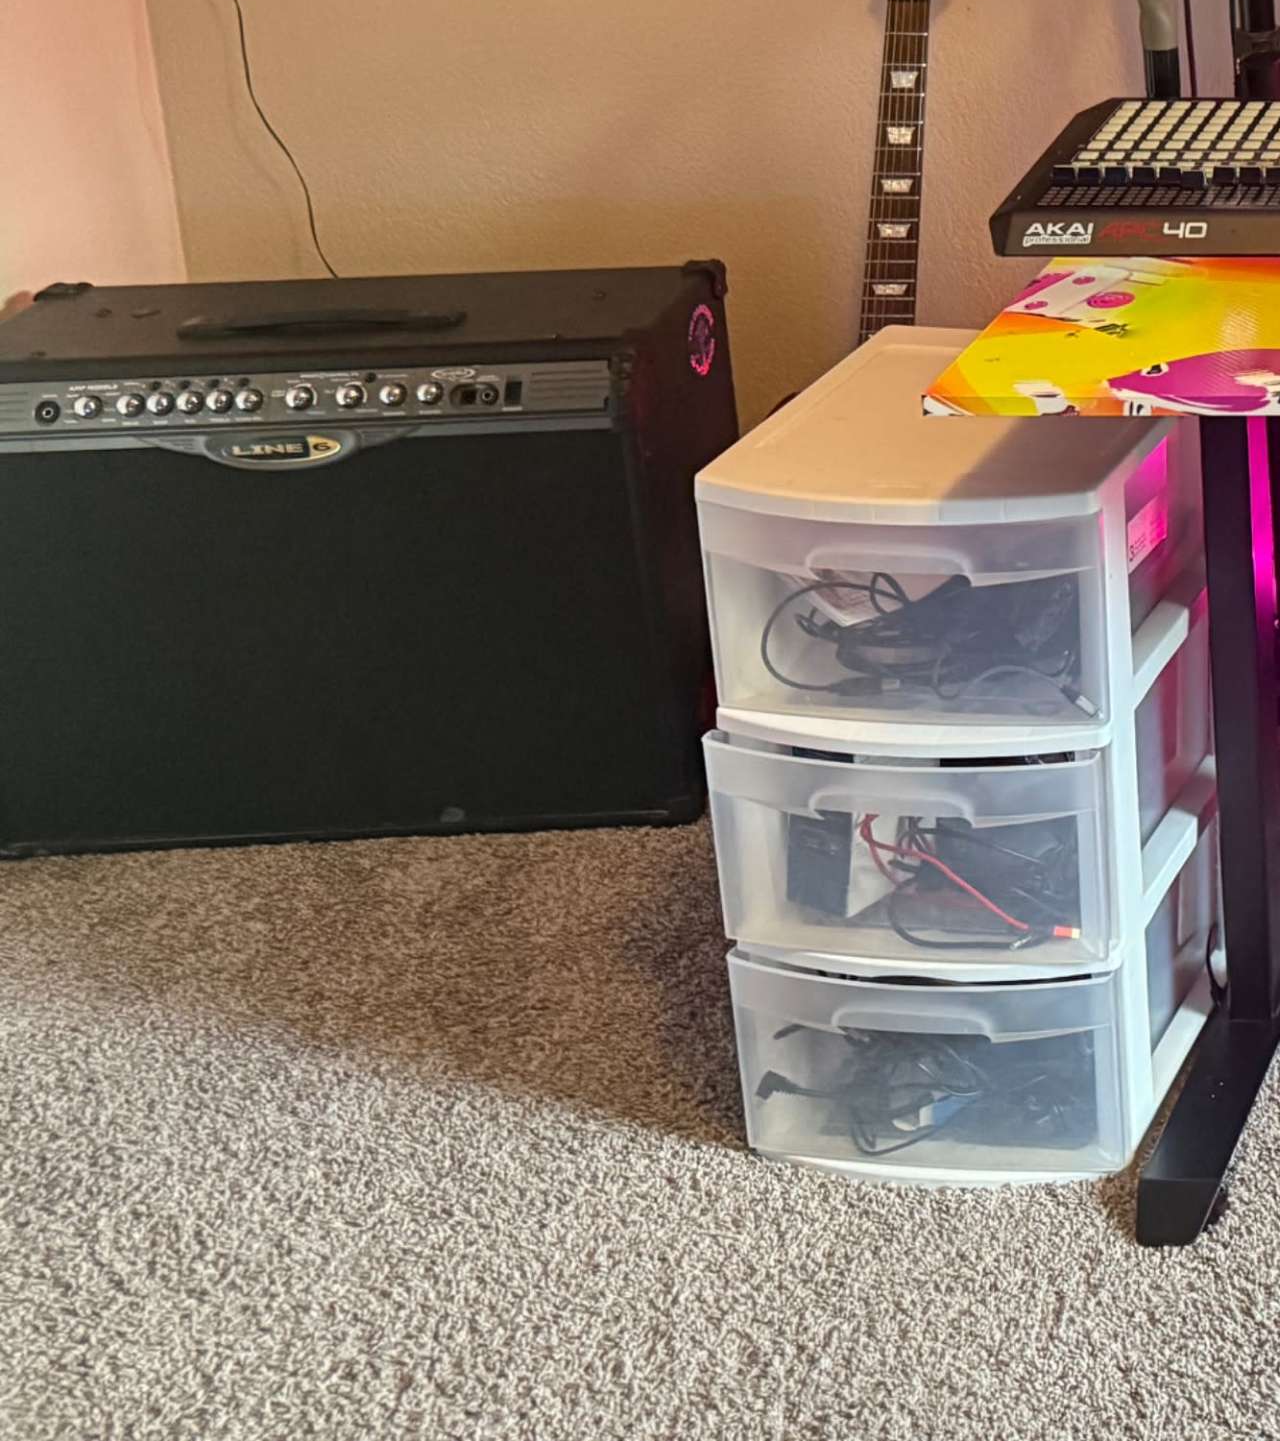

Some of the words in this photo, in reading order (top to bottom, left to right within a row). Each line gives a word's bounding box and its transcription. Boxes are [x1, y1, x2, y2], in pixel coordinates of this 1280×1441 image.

[1026, 222, 1094, 235] AKAI
[1099, 220, 1167, 243] APC
[1163, 222, 1207, 238] 40
[232, 443, 304, 457] LINE
[314, 441, 332, 453] 6
